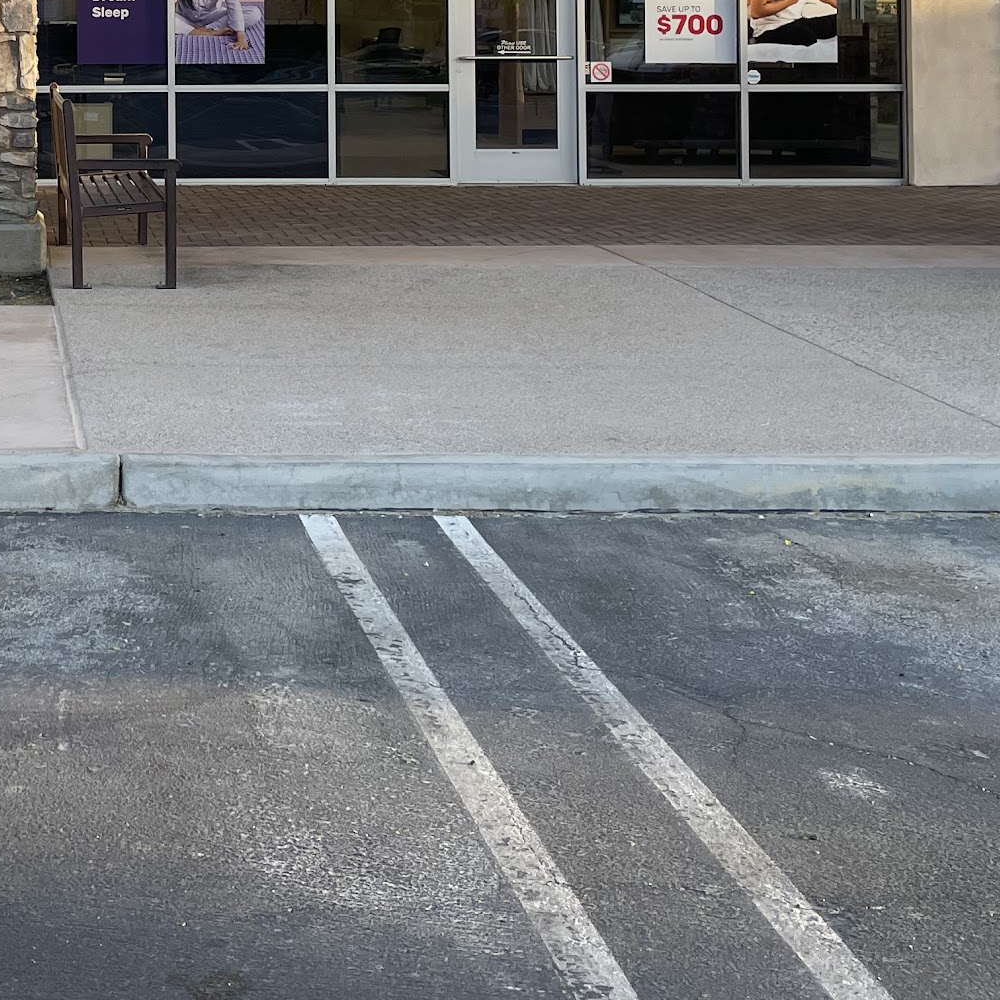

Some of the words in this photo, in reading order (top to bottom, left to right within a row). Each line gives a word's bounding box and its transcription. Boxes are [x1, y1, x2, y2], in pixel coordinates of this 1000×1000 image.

[92, 6, 129, 20] Sleep
[656, 5, 676, 13] SAVE
[678, 5, 690, 13] UP
[690, 5, 701, 13] TO
[657, 14, 724, 35] $700
